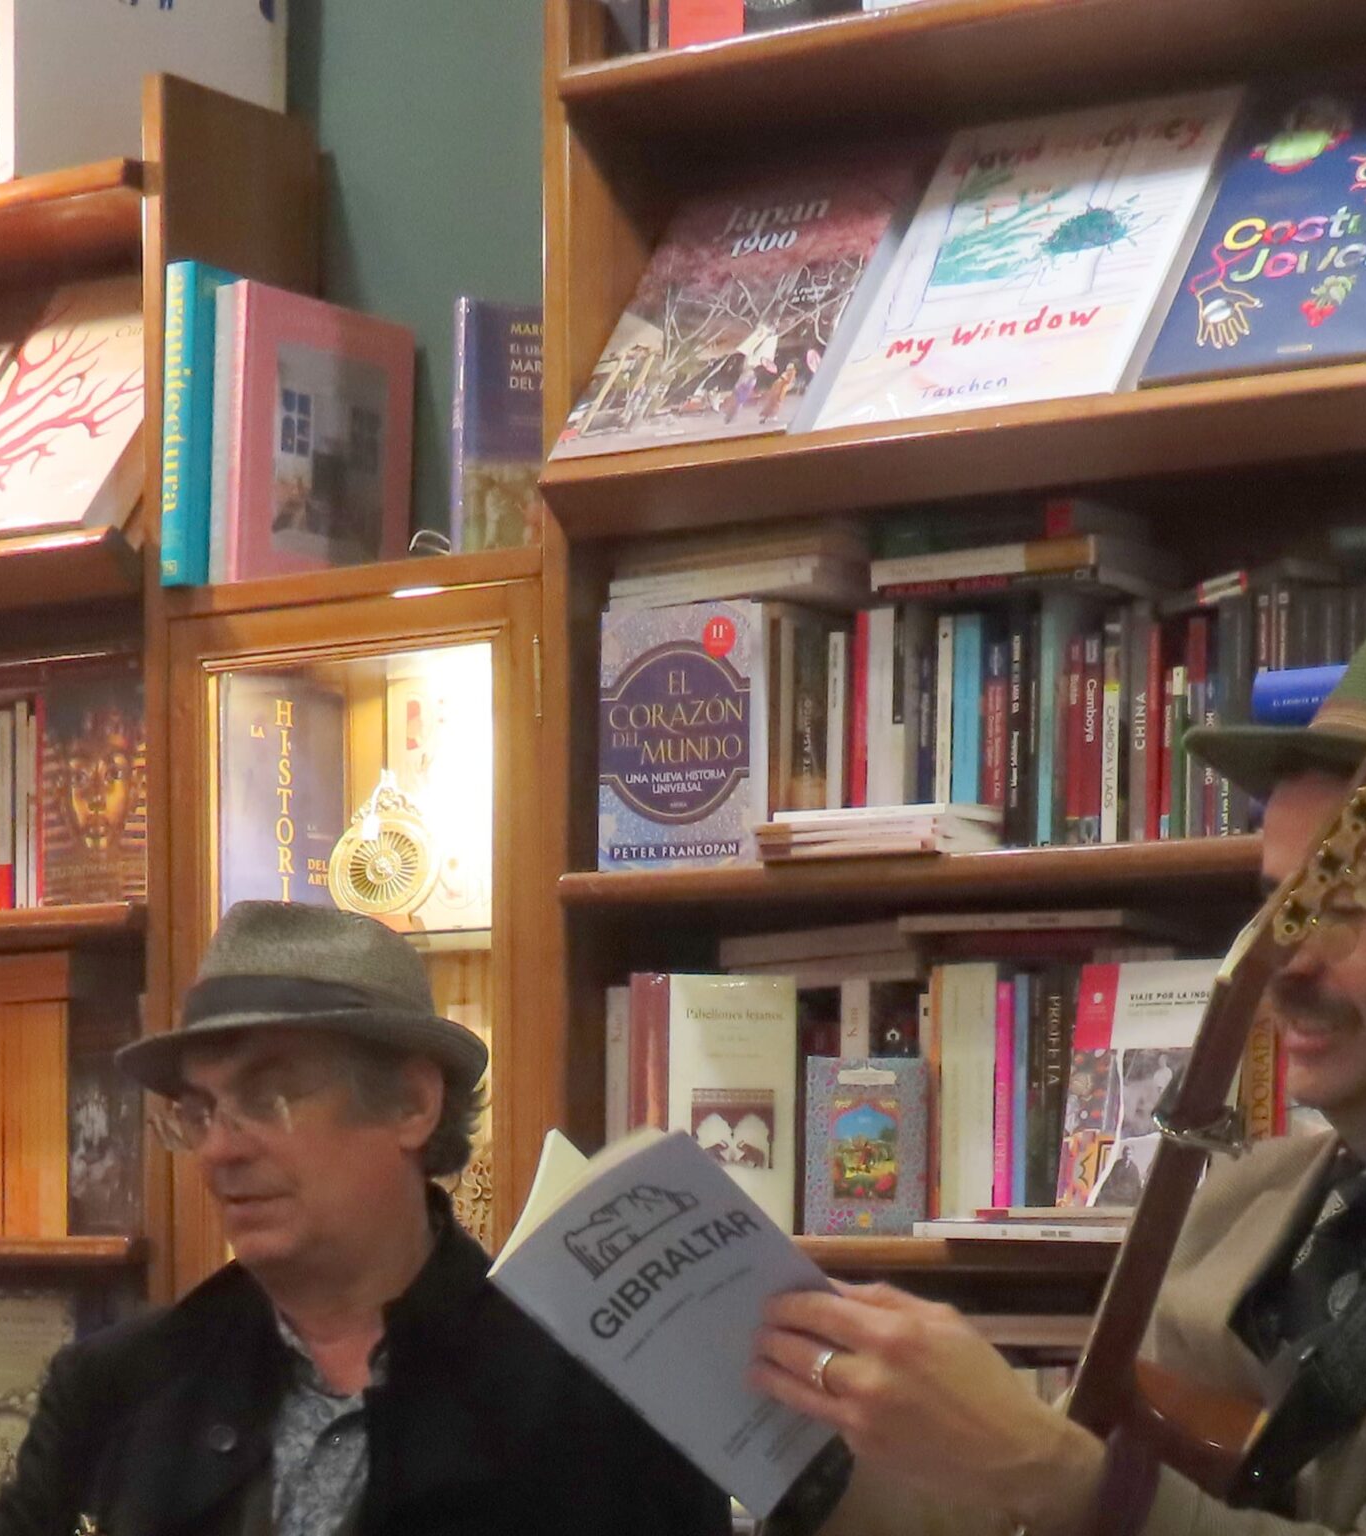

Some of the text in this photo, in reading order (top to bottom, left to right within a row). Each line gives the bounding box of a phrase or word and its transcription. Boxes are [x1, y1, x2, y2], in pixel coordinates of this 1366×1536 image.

[731, 229, 799, 258] 1900
[668, 671, 692, 696] EL
[609, 694, 743, 735] CORAZÓN
[1085, 678, 1097, 744] Camboya
[1135, 693, 1146, 750] CHINA
[640, 733, 742, 766] MUNDO
[626, 768, 727, 784] UNA NUEVA HISTORIA
[652, 781, 702, 795] UNIVERSAL
[275, 699, 295, 904] HISTORI
[613, 842, 737, 860] PETER FRANKOPAN
[307, 858, 327, 872] DEL
[307, 874, 329, 886] ART
[1156, 992, 1173, 1000] POR
[1176, 991, 1187, 1000] LA
[588, 1210, 761, 1340] GIBRALTAR
